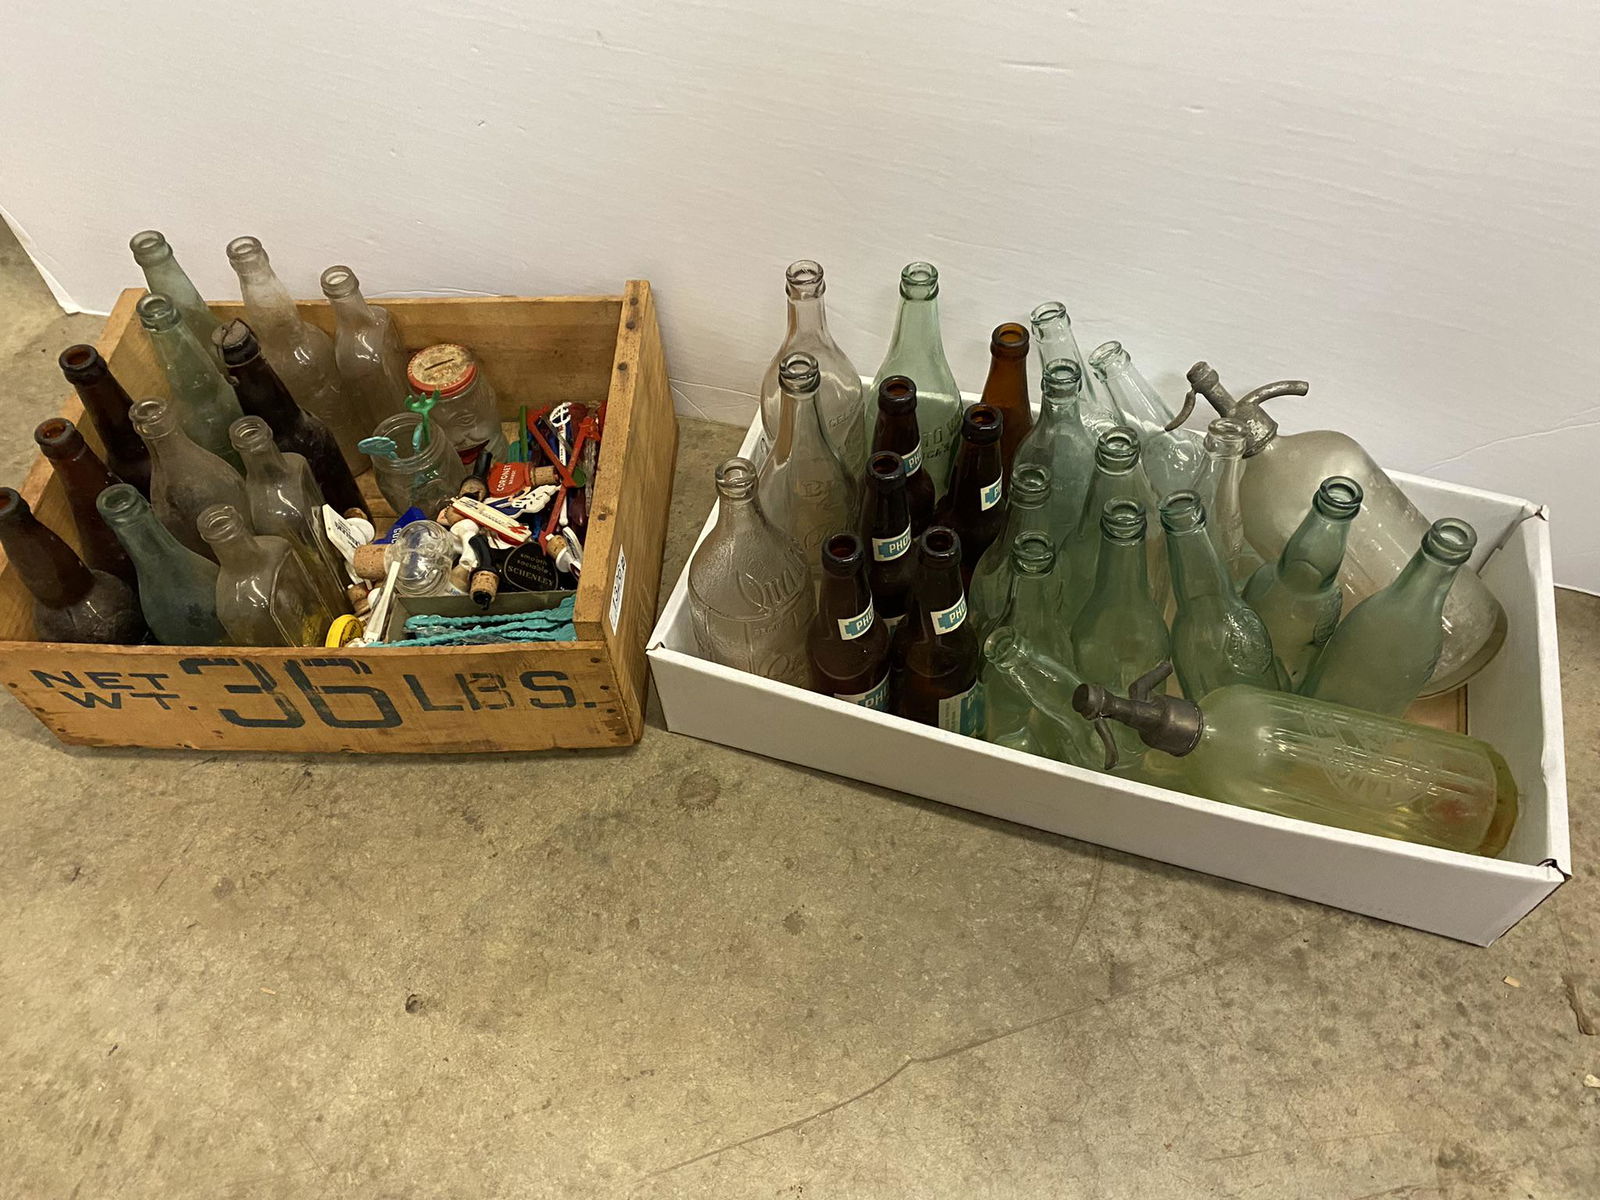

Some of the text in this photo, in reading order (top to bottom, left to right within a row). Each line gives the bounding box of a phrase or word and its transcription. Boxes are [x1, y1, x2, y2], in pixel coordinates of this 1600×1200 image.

[507, 565, 553, 587] SCHENLEY
[29, 669, 169, 690] NET
[59, 691, 198, 710] WT.
[178, 656, 597, 729] 36 LBS.
